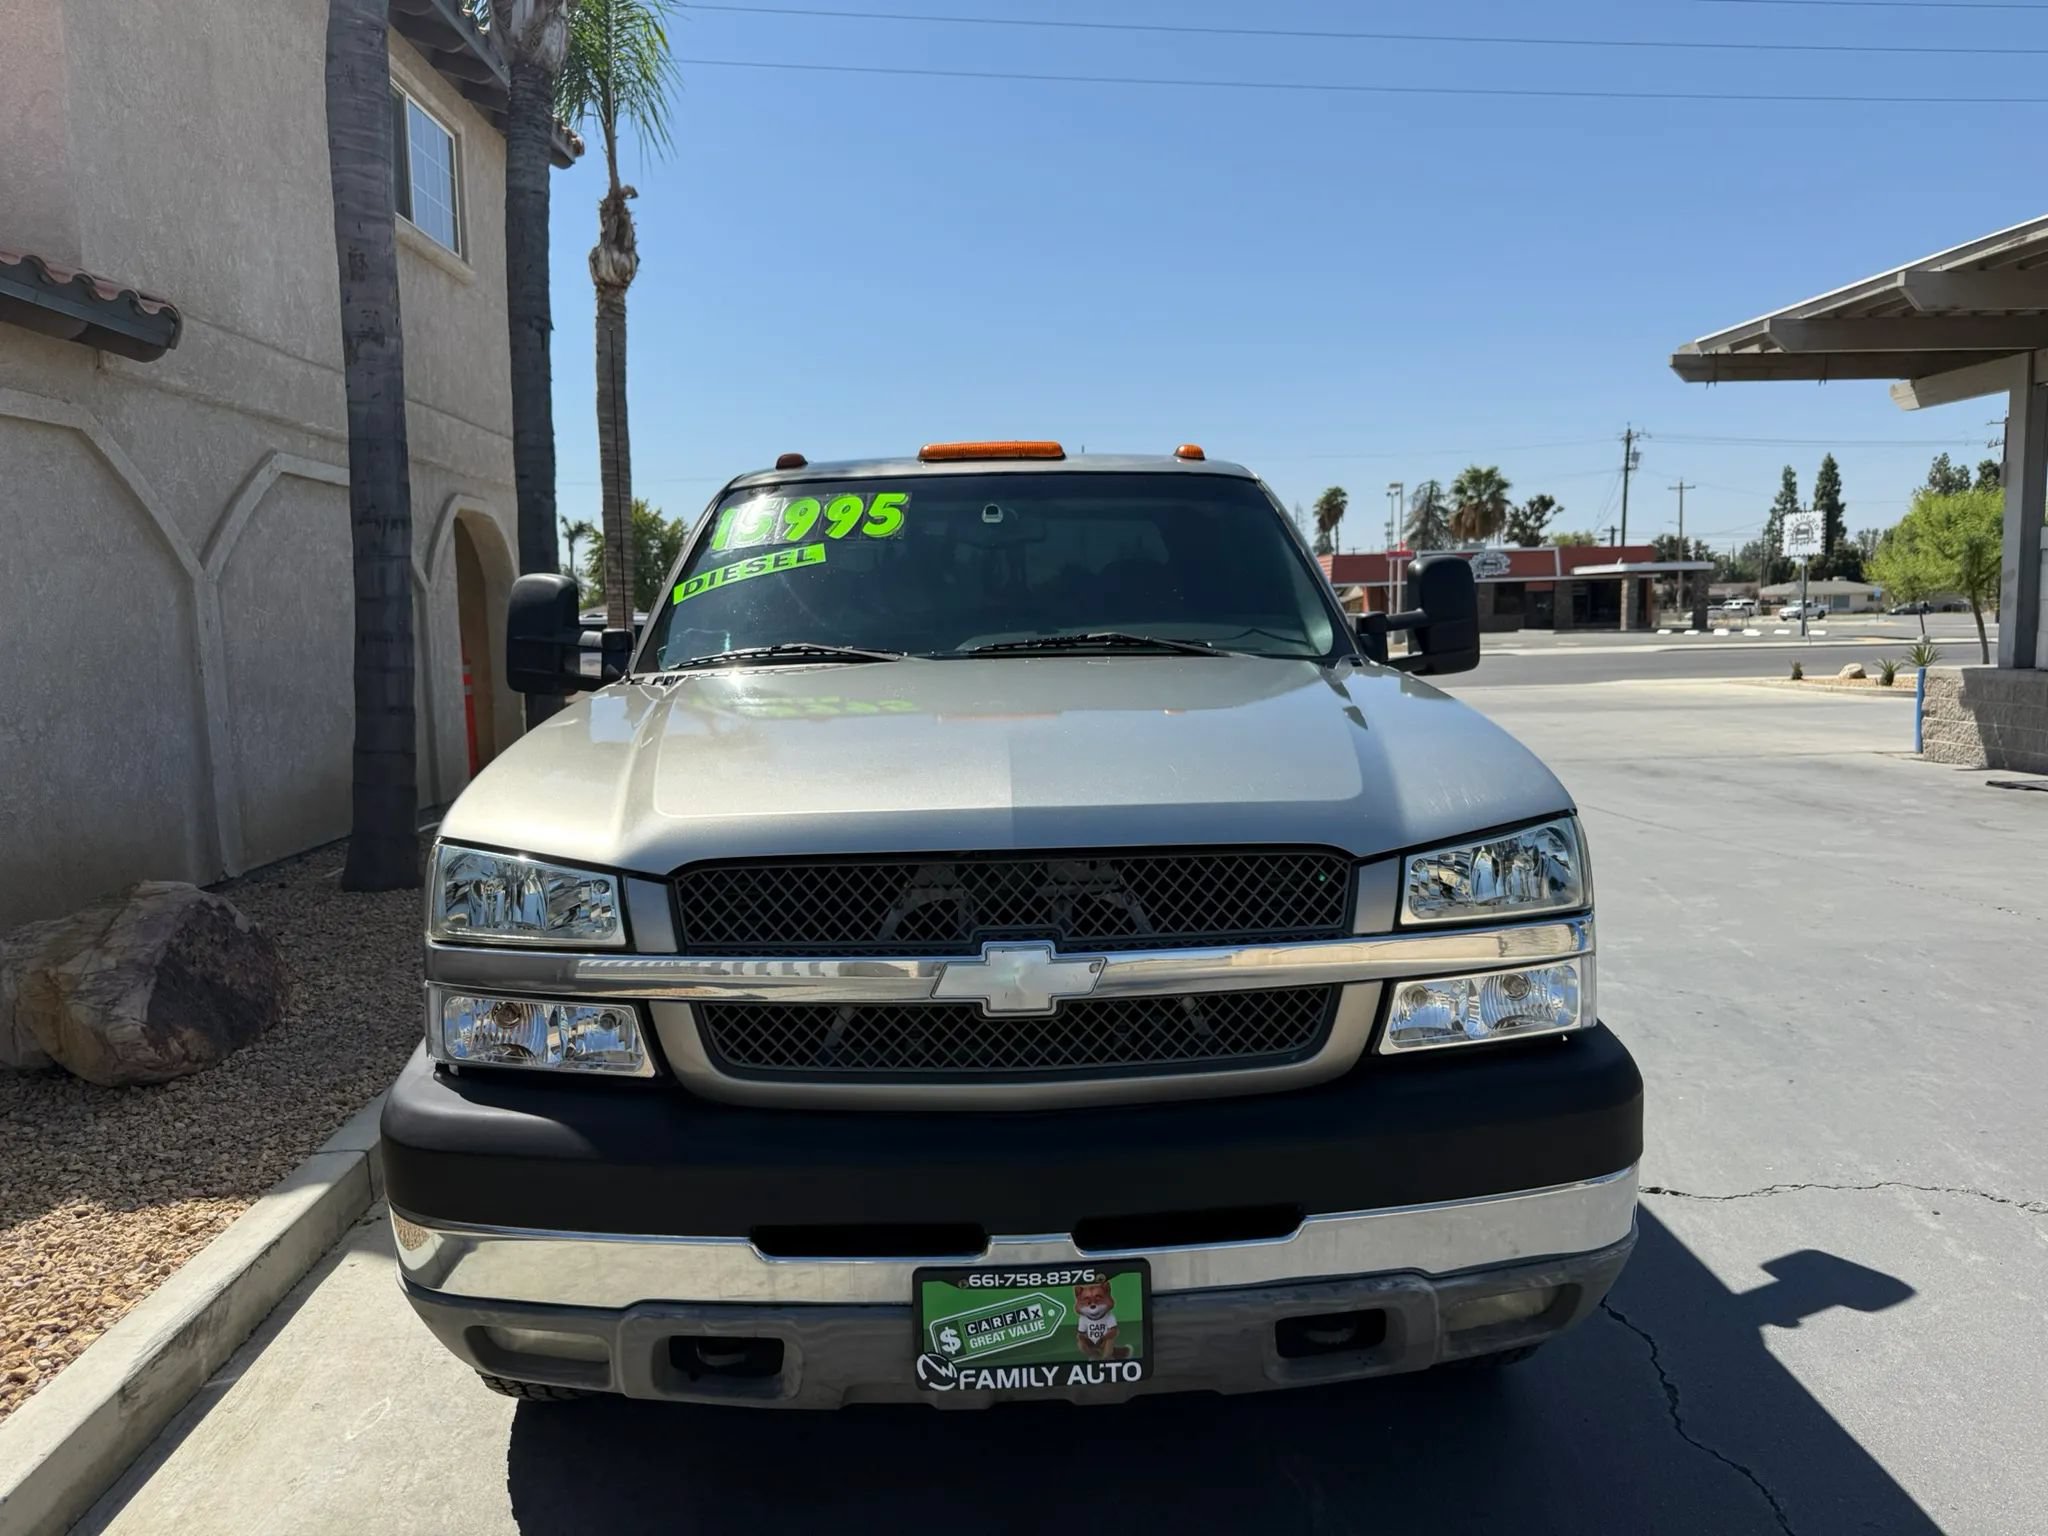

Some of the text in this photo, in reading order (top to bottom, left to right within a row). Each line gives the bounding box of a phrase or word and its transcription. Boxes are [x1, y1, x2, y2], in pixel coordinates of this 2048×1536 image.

[683, 550, 816, 597] DIESEL
[968, 1269, 1095, 1287] 661-758-8376
[967, 1305, 1042, 1334] CARFAX
[1089, 1323, 1106, 1331] CAR
[970, 1320, 1046, 1349] GREAT VALUE
[959, 1362, 1142, 1390] FAMILY AUTO
